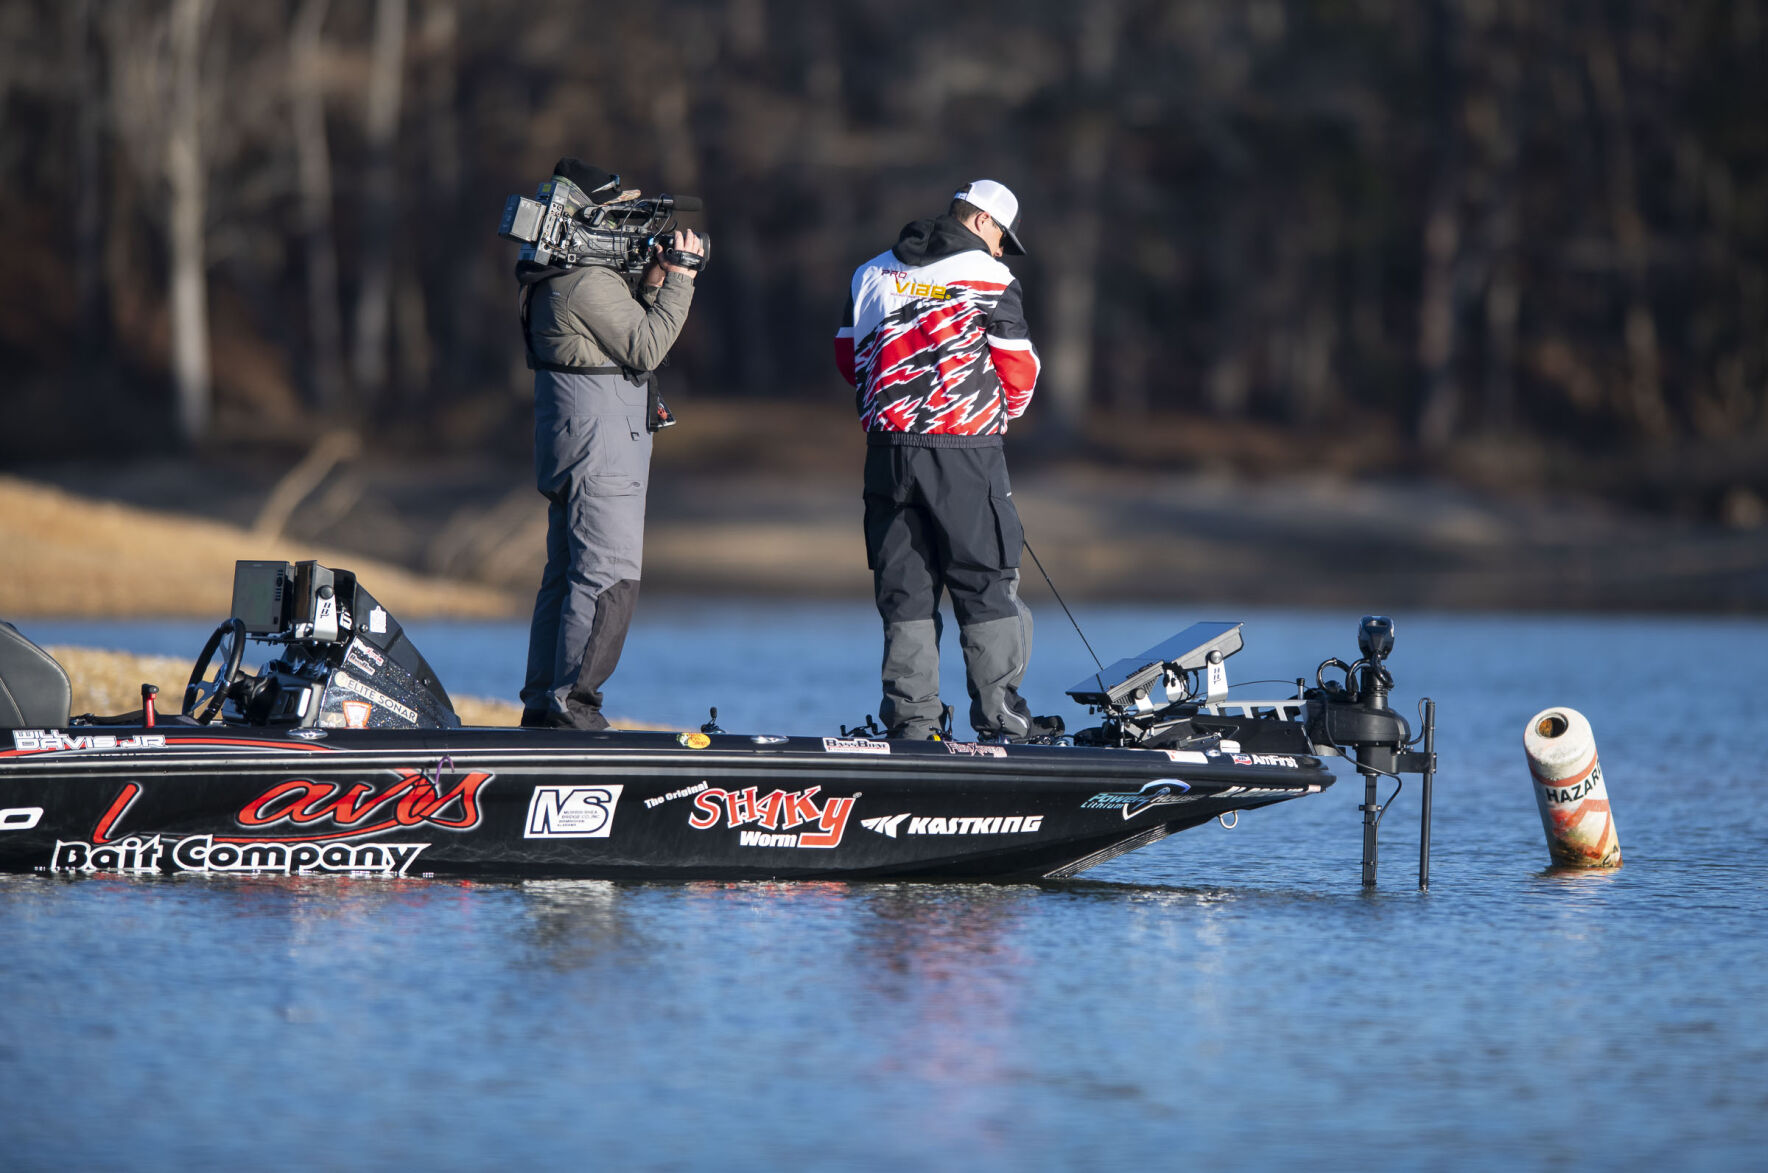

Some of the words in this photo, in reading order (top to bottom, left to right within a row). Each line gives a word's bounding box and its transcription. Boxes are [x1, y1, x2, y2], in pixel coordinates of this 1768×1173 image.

[881, 269, 908, 279] PRO
[347, 679, 376, 699] ELITE
[378, 695, 417, 721] SONAR
[16, 735, 117, 750] DAVIS
[119, 734, 168, 749] JR
[644, 794, 670, 810] The
[665, 781, 709, 801] Original
[1080, 801, 1124, 809] Lithium
[907, 815, 1045, 835] KASTKING
[739, 830, 798, 848] Worm
[51, 834, 163, 872] Bait
[172, 834, 431, 874] Company
